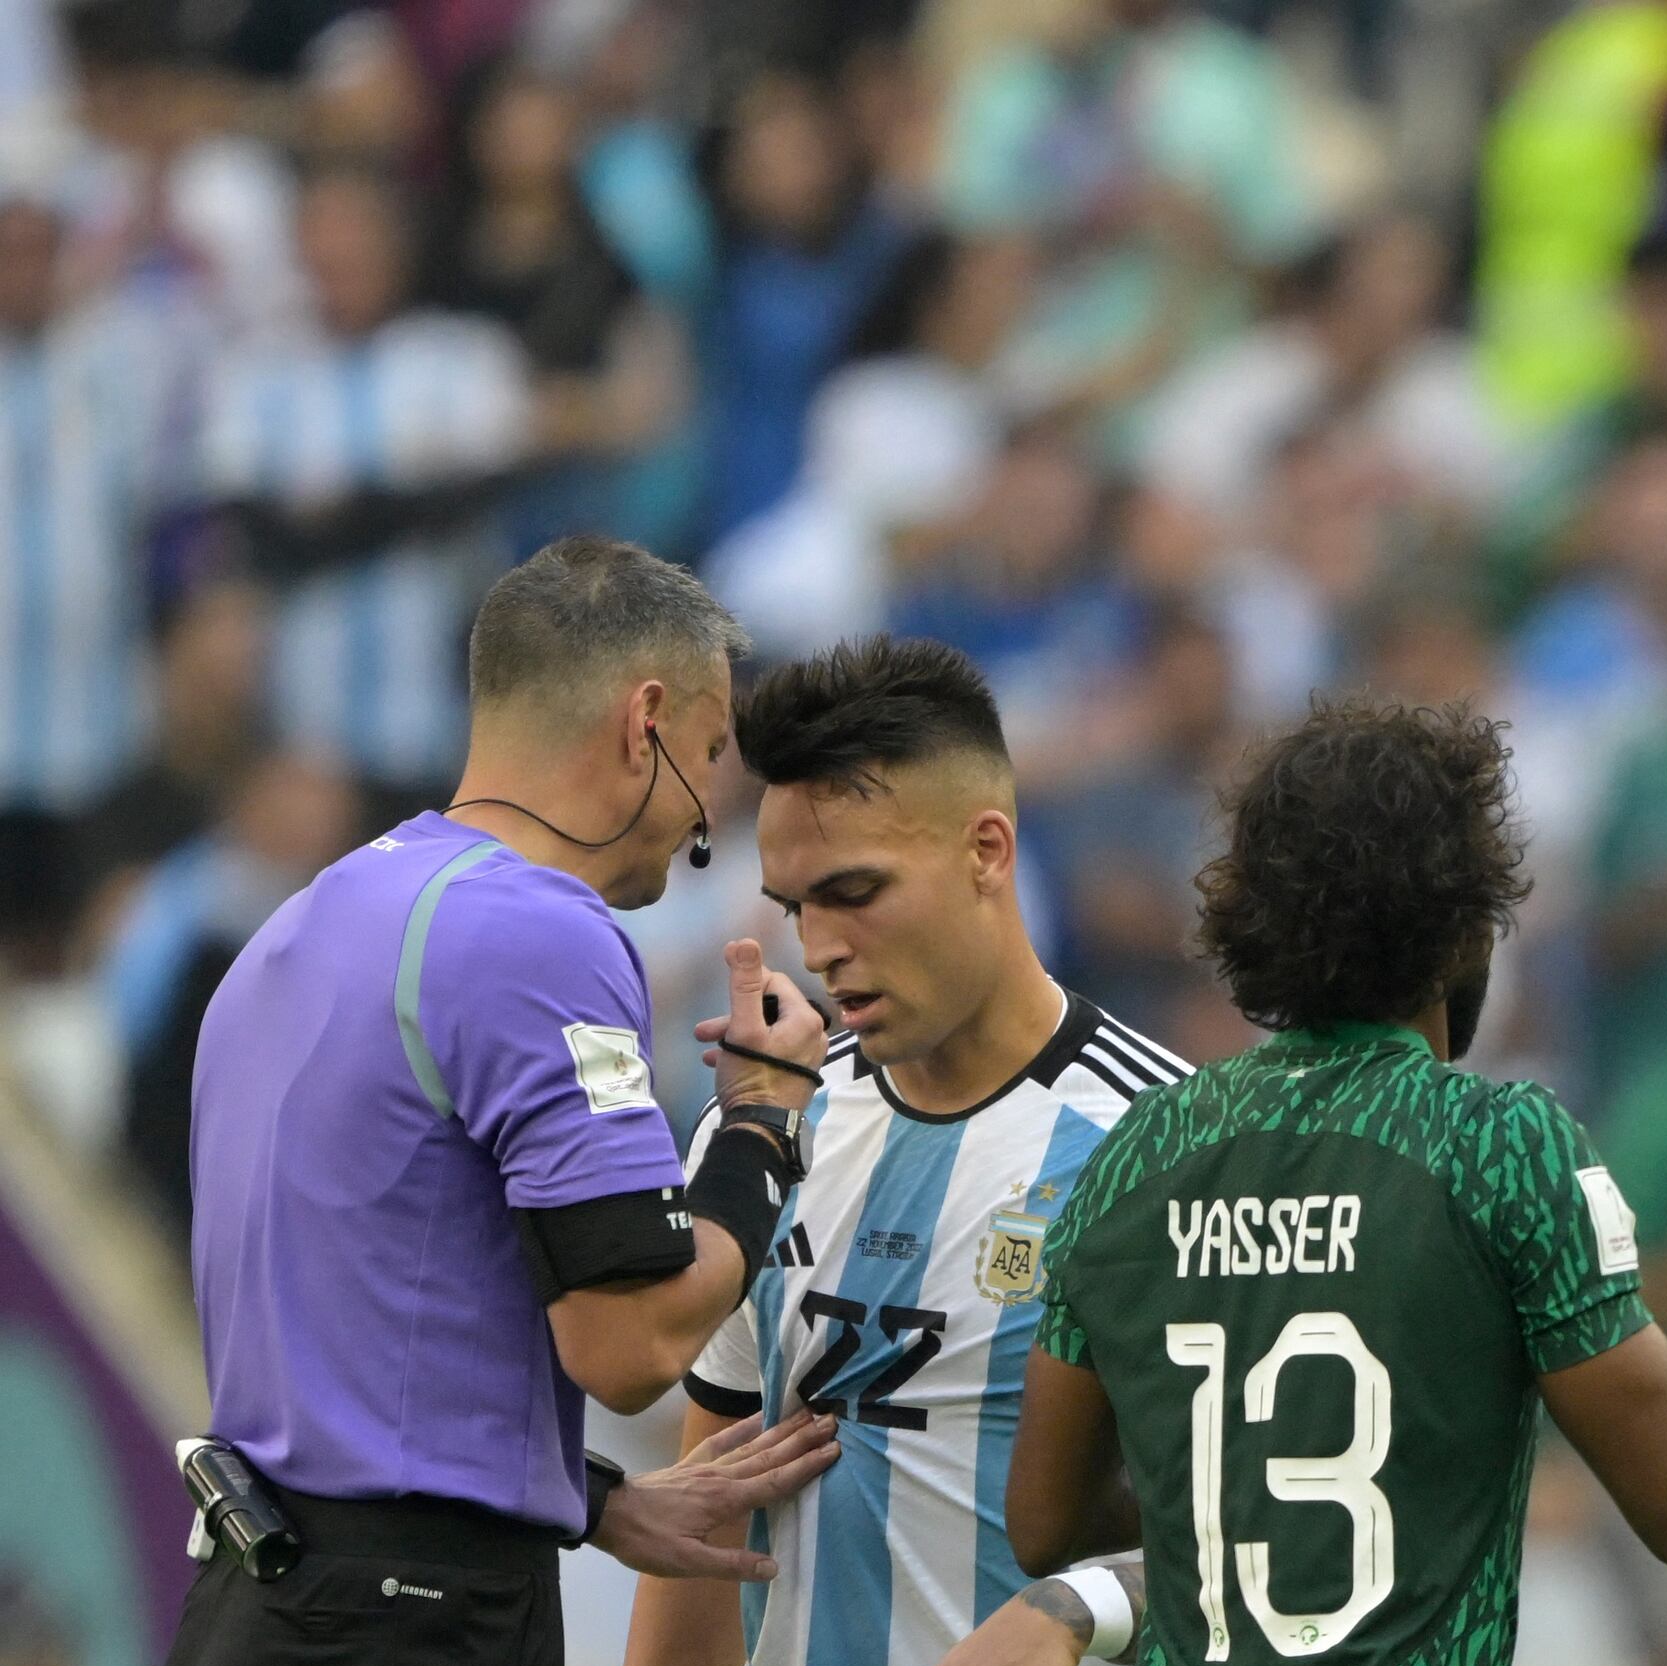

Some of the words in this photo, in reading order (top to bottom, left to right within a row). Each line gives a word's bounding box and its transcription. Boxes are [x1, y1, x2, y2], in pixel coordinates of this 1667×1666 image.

[991, 1235, 1032, 1280] AFA
[1168, 1195, 1361, 1277] YASSER
[797, 1290, 947, 1432] 22
[1166, 1311, 1394, 1662] 13
[400, 1585, 443, 1600] AEROREADY
